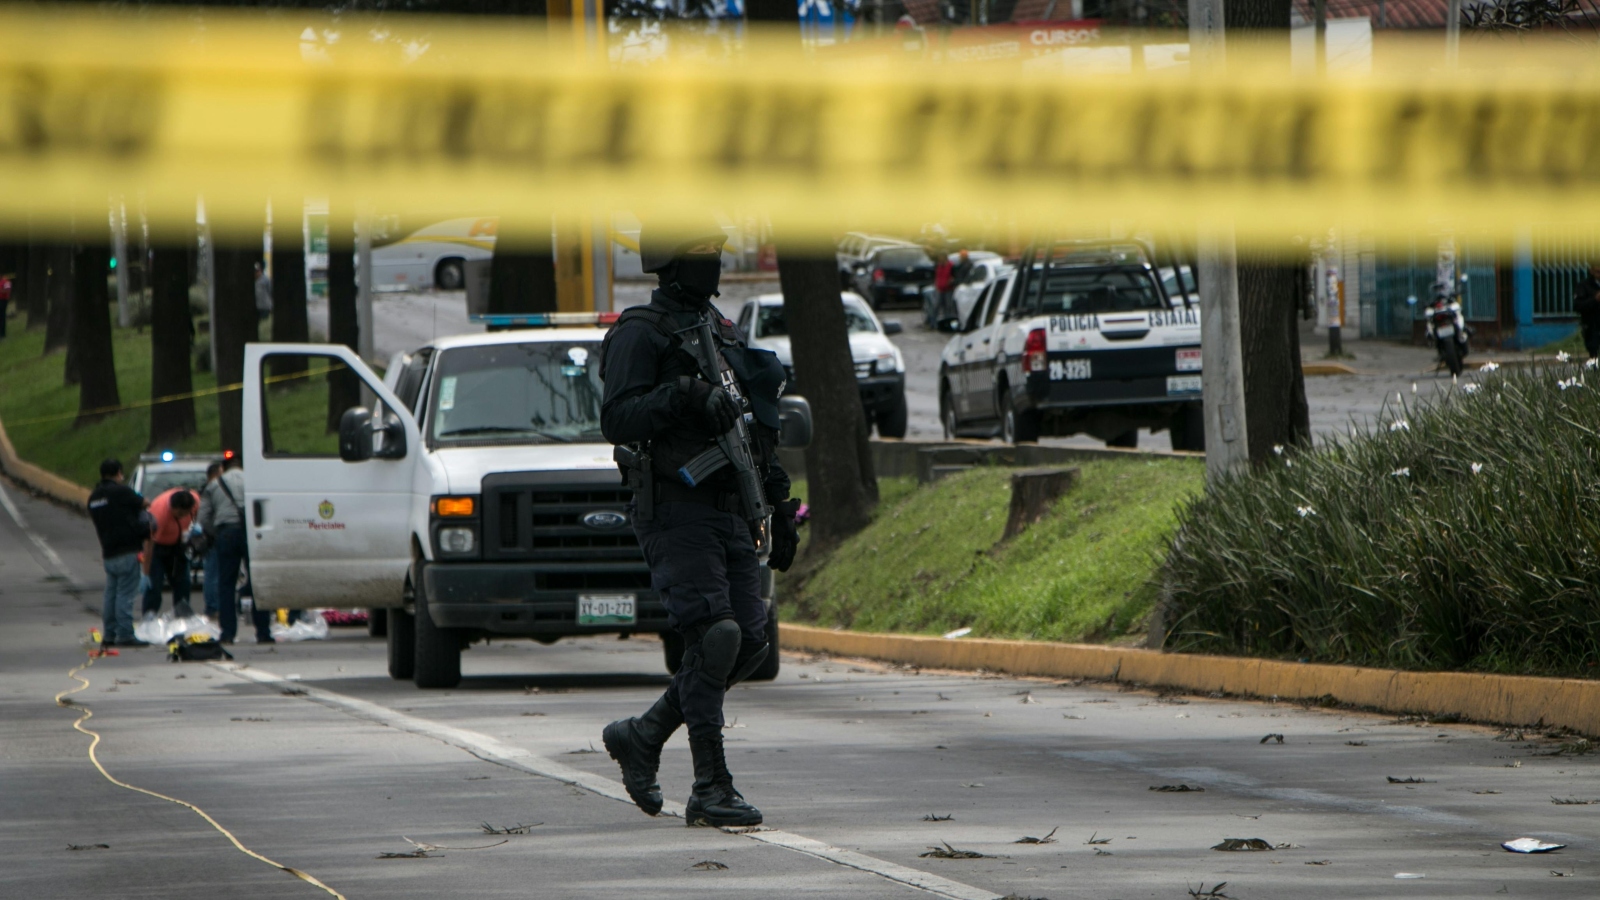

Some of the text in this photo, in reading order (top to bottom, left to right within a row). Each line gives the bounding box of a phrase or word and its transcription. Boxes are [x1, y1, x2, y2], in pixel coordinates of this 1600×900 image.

[1050, 310, 1198, 332] POLICIA ESTATAL
[309, 521, 345, 530] Periciales
[582, 603, 632, 614] XY-01-273
